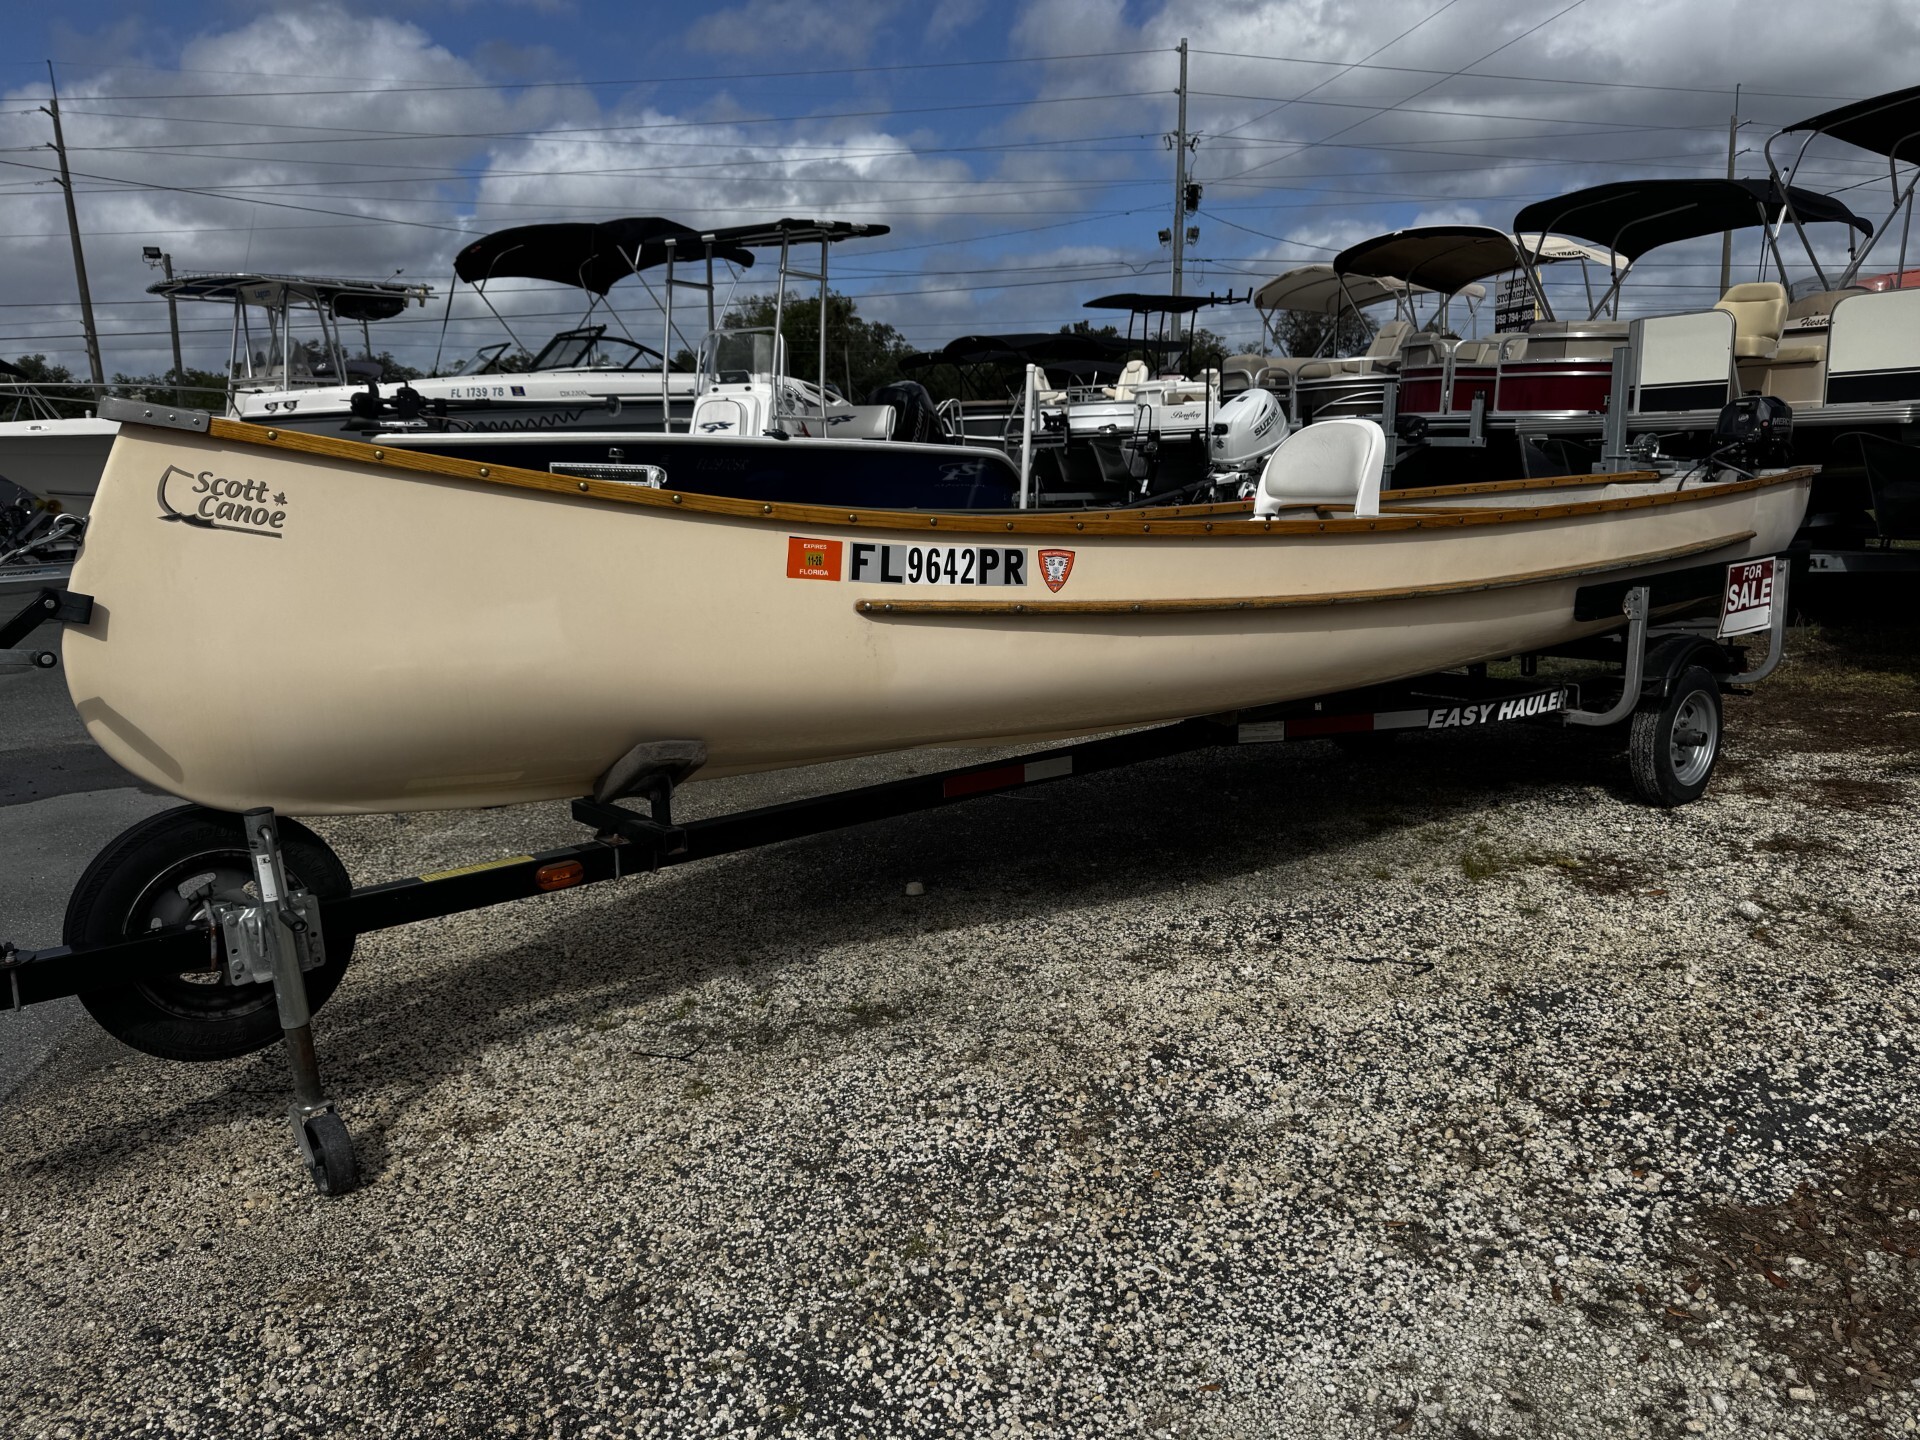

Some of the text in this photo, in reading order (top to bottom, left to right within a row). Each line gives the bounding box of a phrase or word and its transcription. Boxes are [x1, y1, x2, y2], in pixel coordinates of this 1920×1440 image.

[450, 388, 462, 398] FL
[466, 387, 488, 398] 1739
[1170, 411, 1202, 420] Bentley
[1254, 407, 1278, 437] SUZUKI
[191, 471, 270, 504] Scott
[197, 495, 287, 529] Canoe
[799, 568, 829, 577] FLORIDA
[1742, 564, 1763, 580] FOR
[1727, 577, 1772, 612] SALE
[1428, 703, 1496, 729] EASY
[1497, 689, 1569, 721] HAULER
